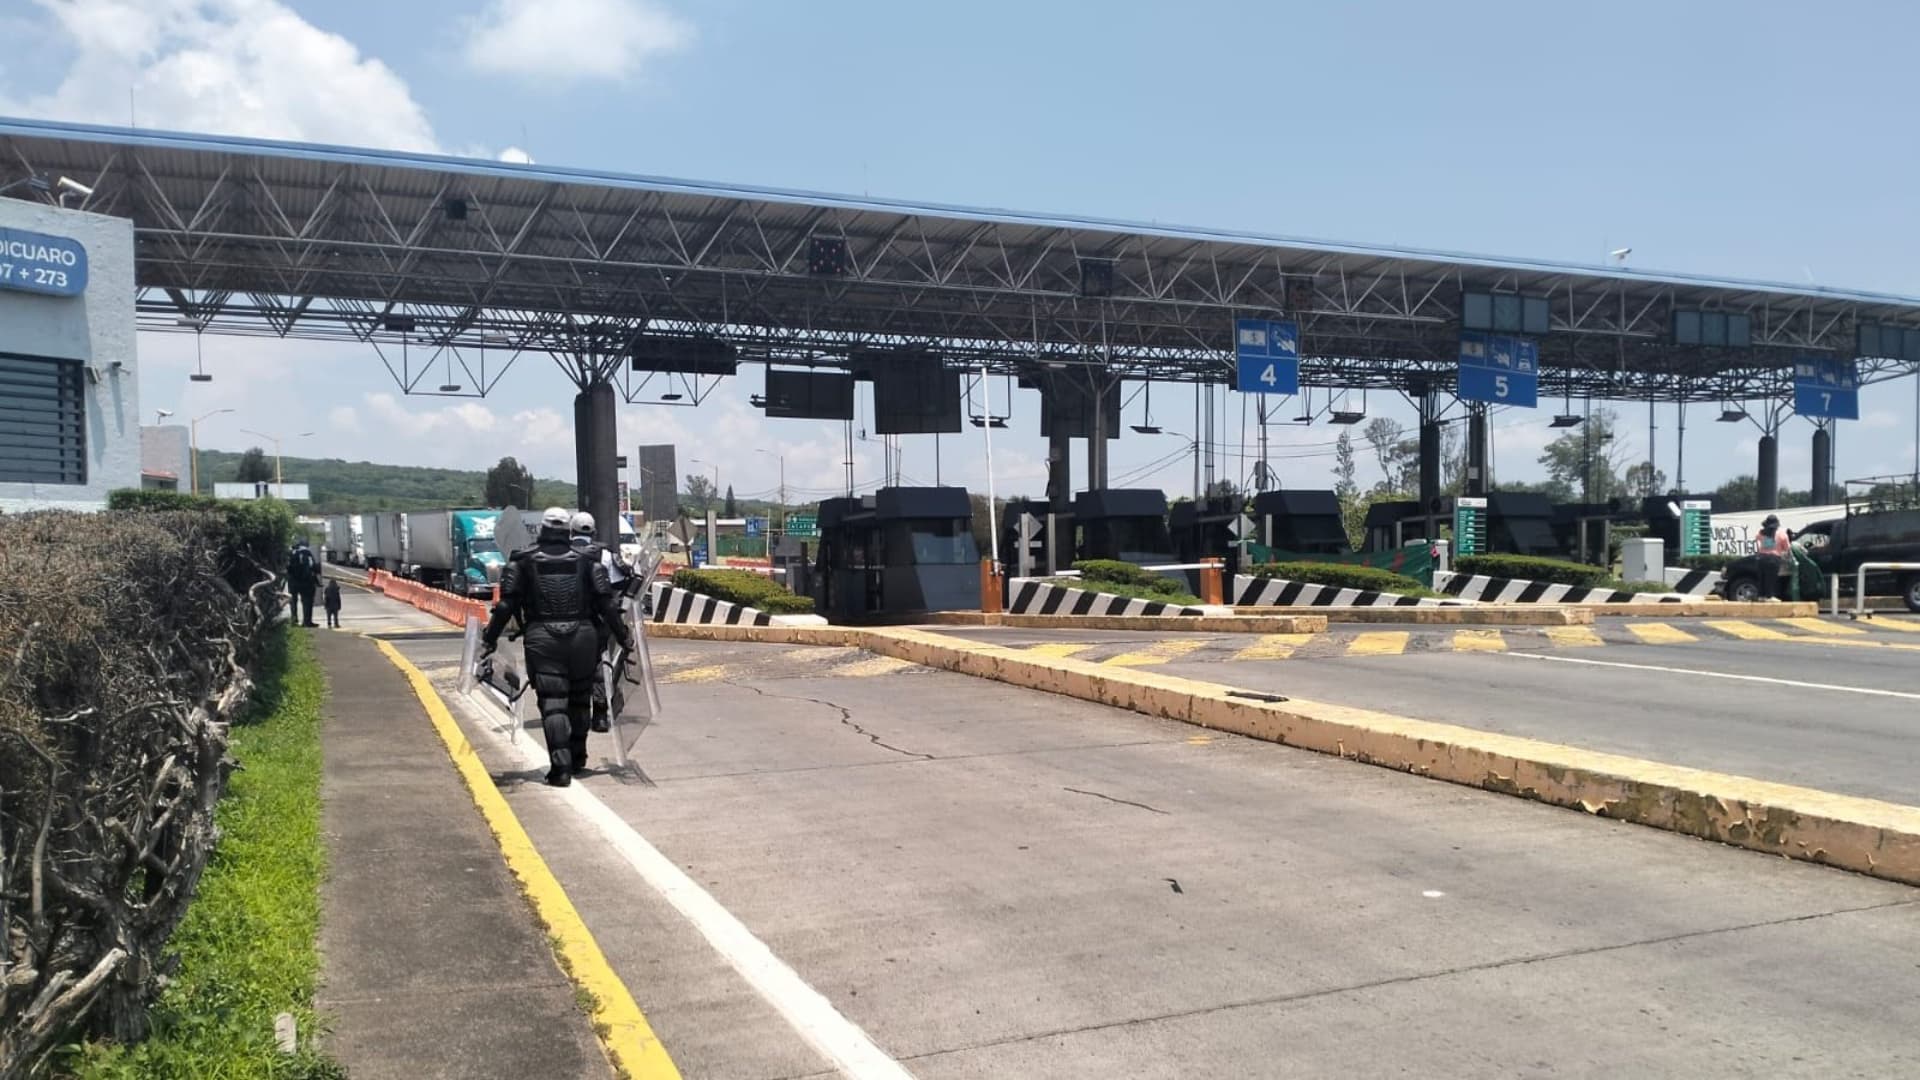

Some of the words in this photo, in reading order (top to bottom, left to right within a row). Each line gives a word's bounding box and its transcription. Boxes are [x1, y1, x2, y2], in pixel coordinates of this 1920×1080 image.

[34, 268, 68, 287] 273
[1260, 363, 1277, 387] 4
[1495, 375, 1509, 397] 5
[1820, 392, 1831, 412] 7
